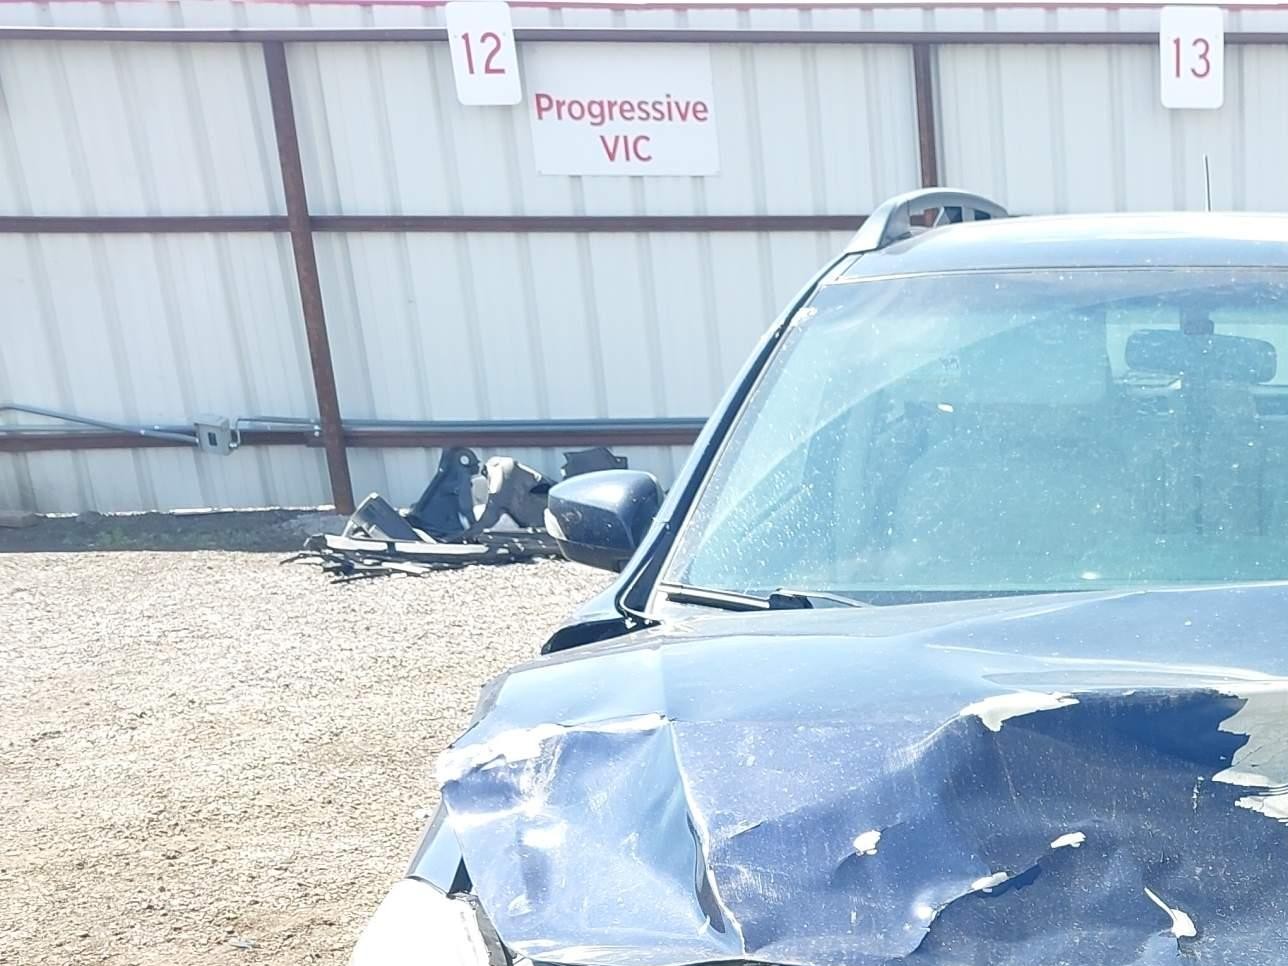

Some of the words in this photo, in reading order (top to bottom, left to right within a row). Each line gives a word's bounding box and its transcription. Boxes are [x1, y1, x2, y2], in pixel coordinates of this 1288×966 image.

[461, 32, 506, 75] 12
[1173, 37, 1211, 78] 13
[535, 92, 709, 127] Progressive
[599, 134, 653, 163] VIC
